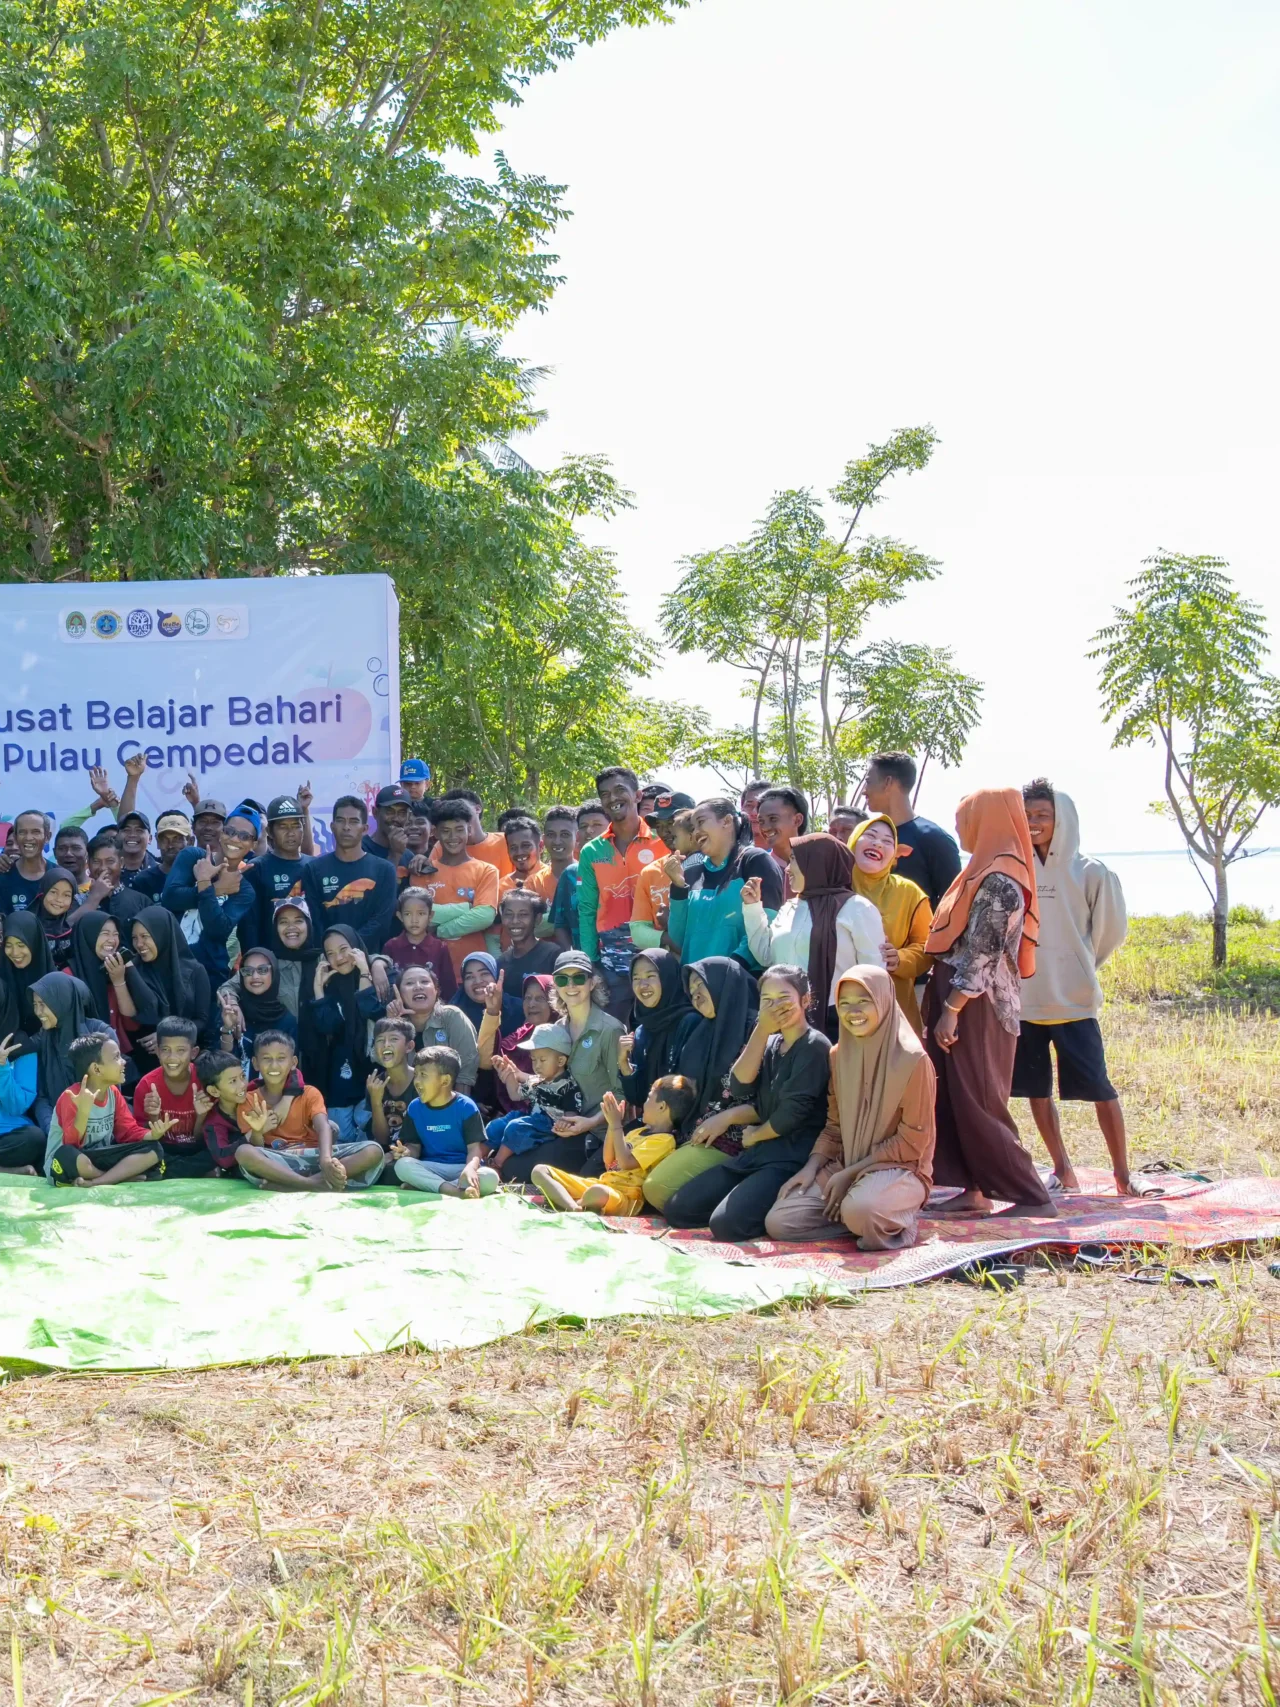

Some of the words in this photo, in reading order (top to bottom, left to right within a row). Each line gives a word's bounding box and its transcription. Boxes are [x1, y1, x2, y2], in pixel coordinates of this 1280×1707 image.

[87, 698, 215, 737] Belajar
[228, 694, 343, 726] Bahari
[3, 741, 102, 773] Pulau
[117, 734, 315, 776] Cempedak
